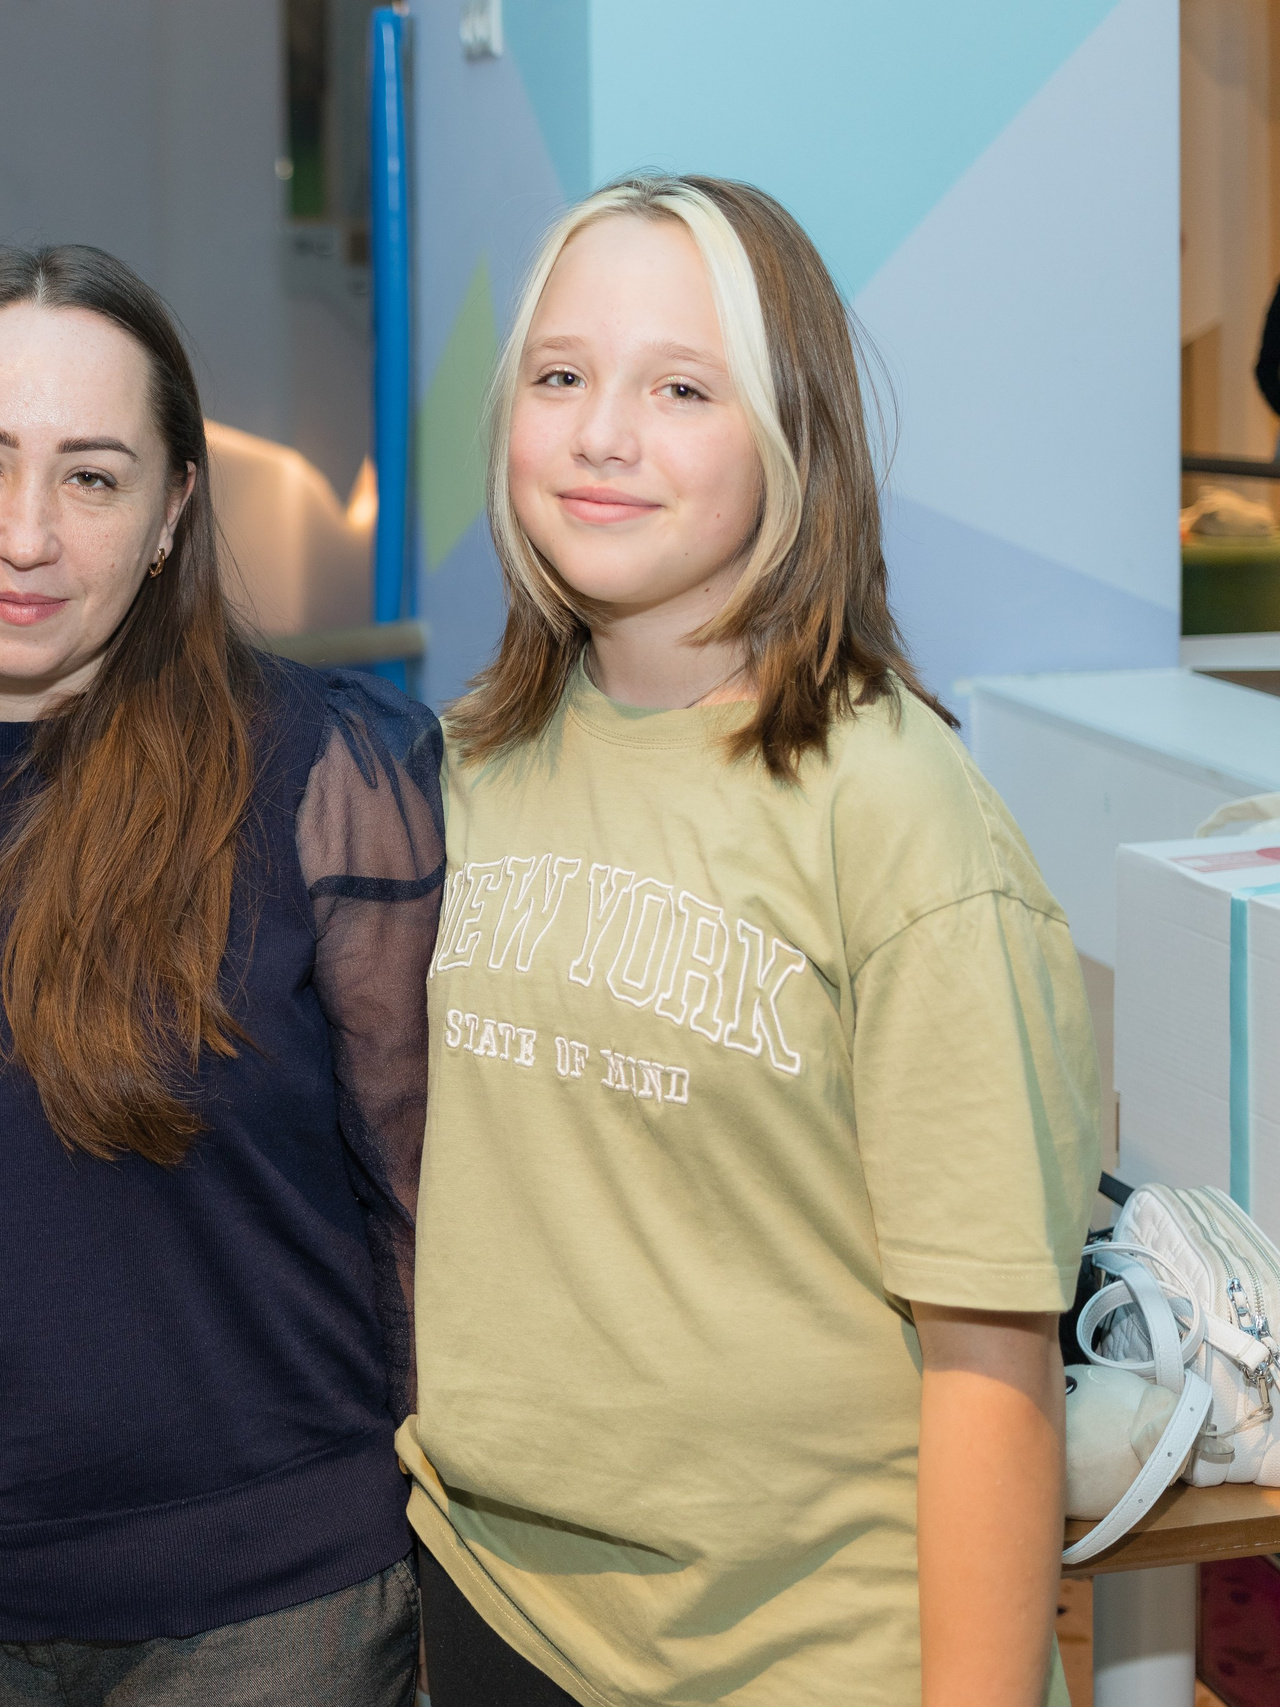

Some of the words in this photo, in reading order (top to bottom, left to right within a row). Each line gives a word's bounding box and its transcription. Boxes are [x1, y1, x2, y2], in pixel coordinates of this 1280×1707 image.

[568, 862, 807, 1076] YORK
[445, 1008, 537, 1068] STATE
[554, 1036, 589, 1079] OF
[600, 1049, 690, 1105] MIND
